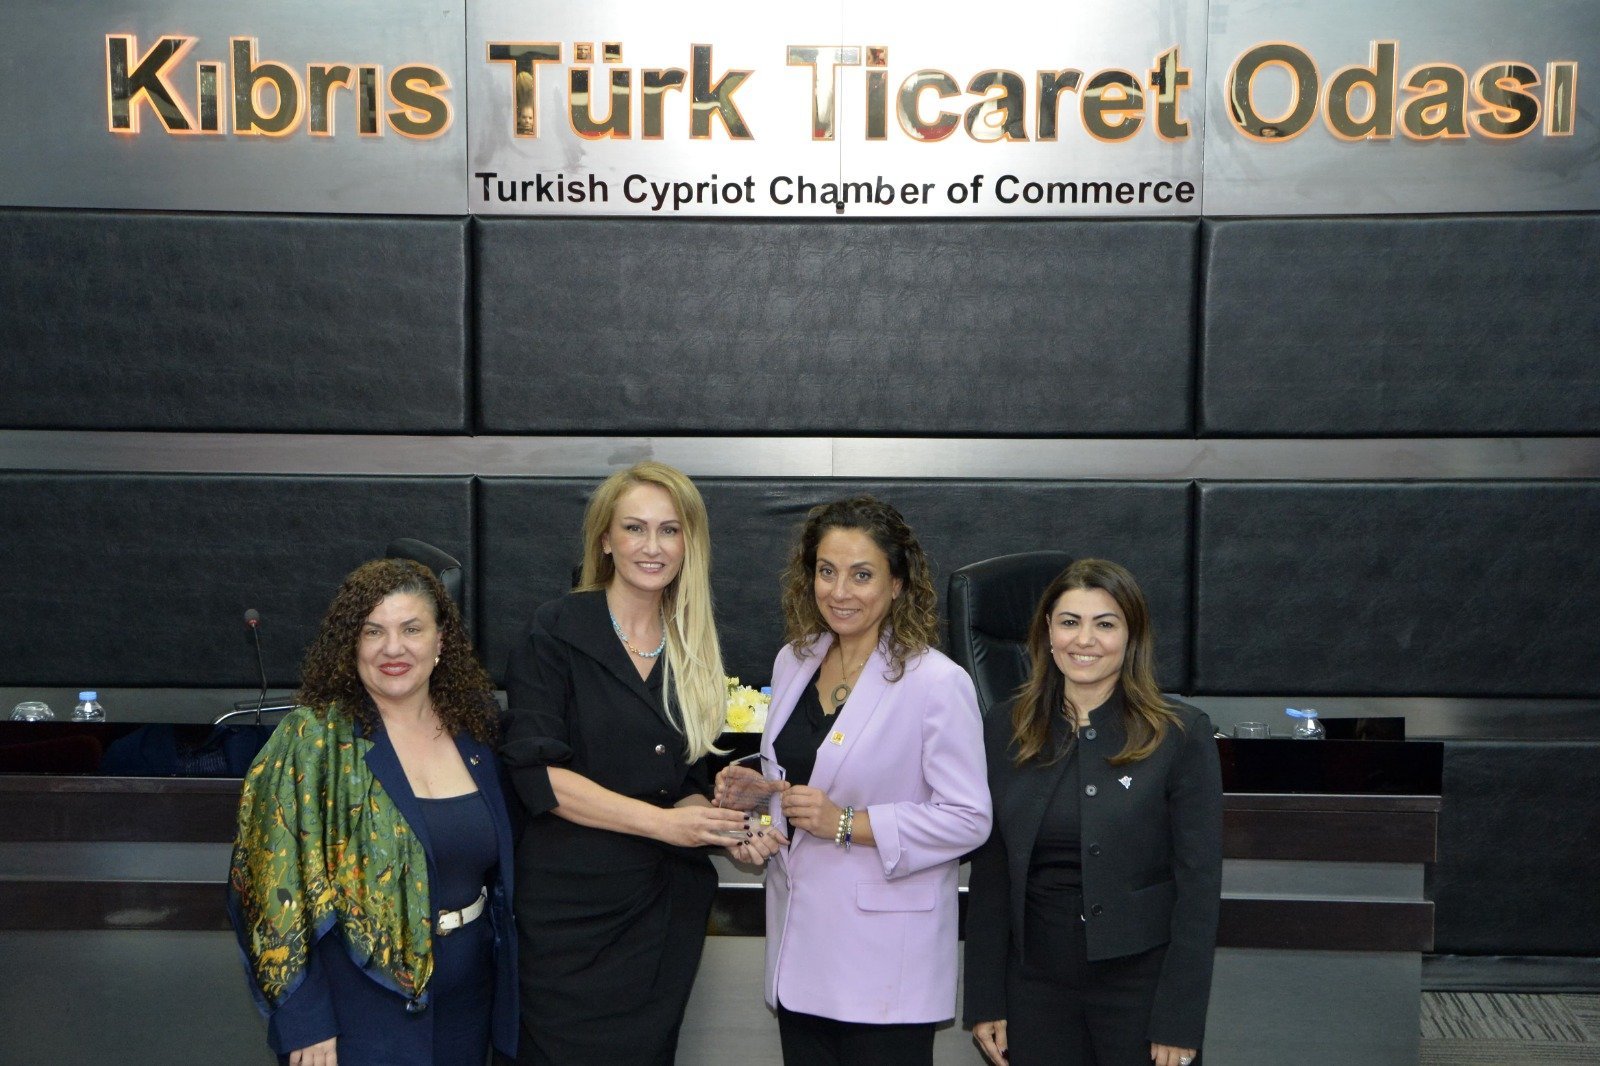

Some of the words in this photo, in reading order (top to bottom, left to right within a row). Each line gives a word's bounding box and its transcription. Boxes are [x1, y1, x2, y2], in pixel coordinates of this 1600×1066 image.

[106, 34, 452, 139] Kıbrıs
[486, 41, 755, 141] Türk
[786, 42, 1192, 143] Ticaret
[1224, 40, 1578, 143] Odası
[475, 172, 608, 203] Turkish
[623, 173, 755, 211] Cypriot
[769, 175, 935, 204] Chamber
[947, 174, 984, 204] of
[995, 174, 1195, 204] Commerce
